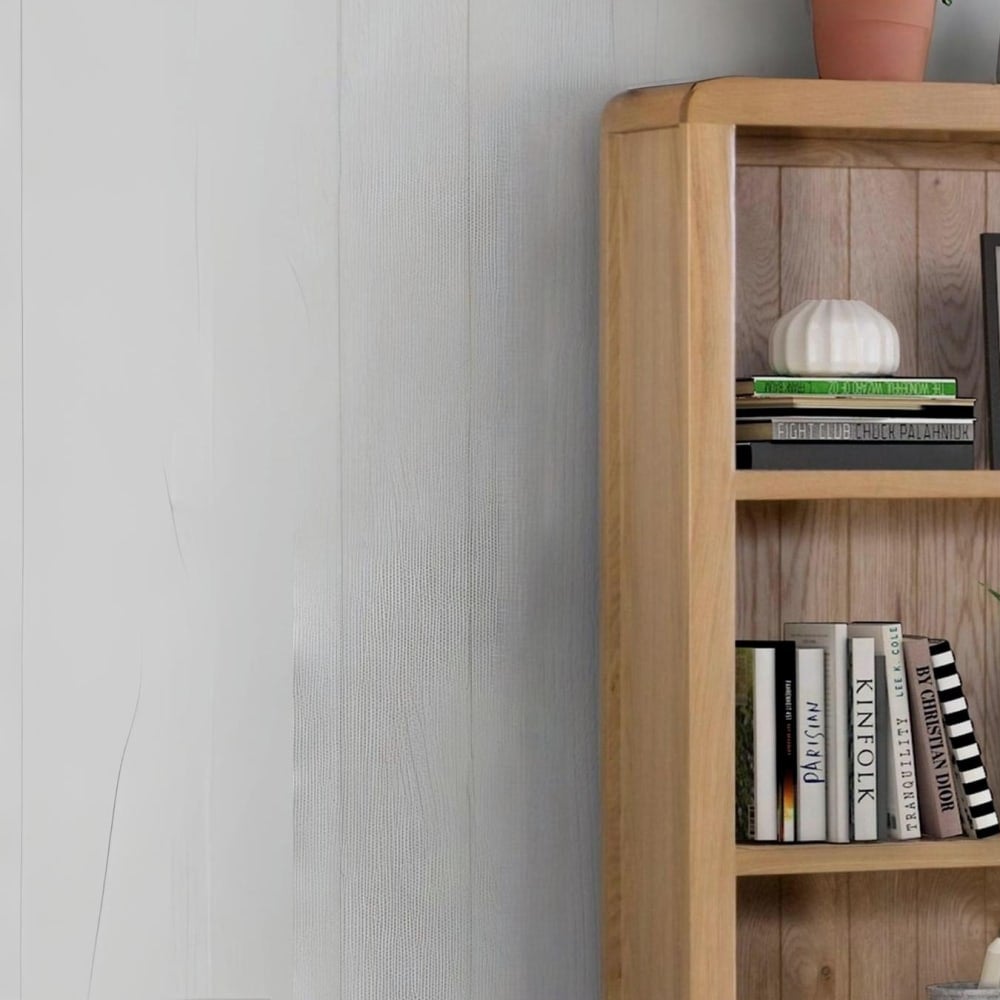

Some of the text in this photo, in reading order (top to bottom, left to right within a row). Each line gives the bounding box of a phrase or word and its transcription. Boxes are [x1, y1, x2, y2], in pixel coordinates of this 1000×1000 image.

[777, 423, 969, 440] FIGHT CLUB CHUCK PALAHNIUK
[889, 627, 900, 655] COLE
[895, 678, 904, 697] LEE
[800, 701, 825, 783] PARISIAN
[856, 679, 875, 803] KINFOLK
[896, 718, 917, 831] TRANQUILITY
[916, 665, 955, 812] BY CHRISTIAN DIOR
